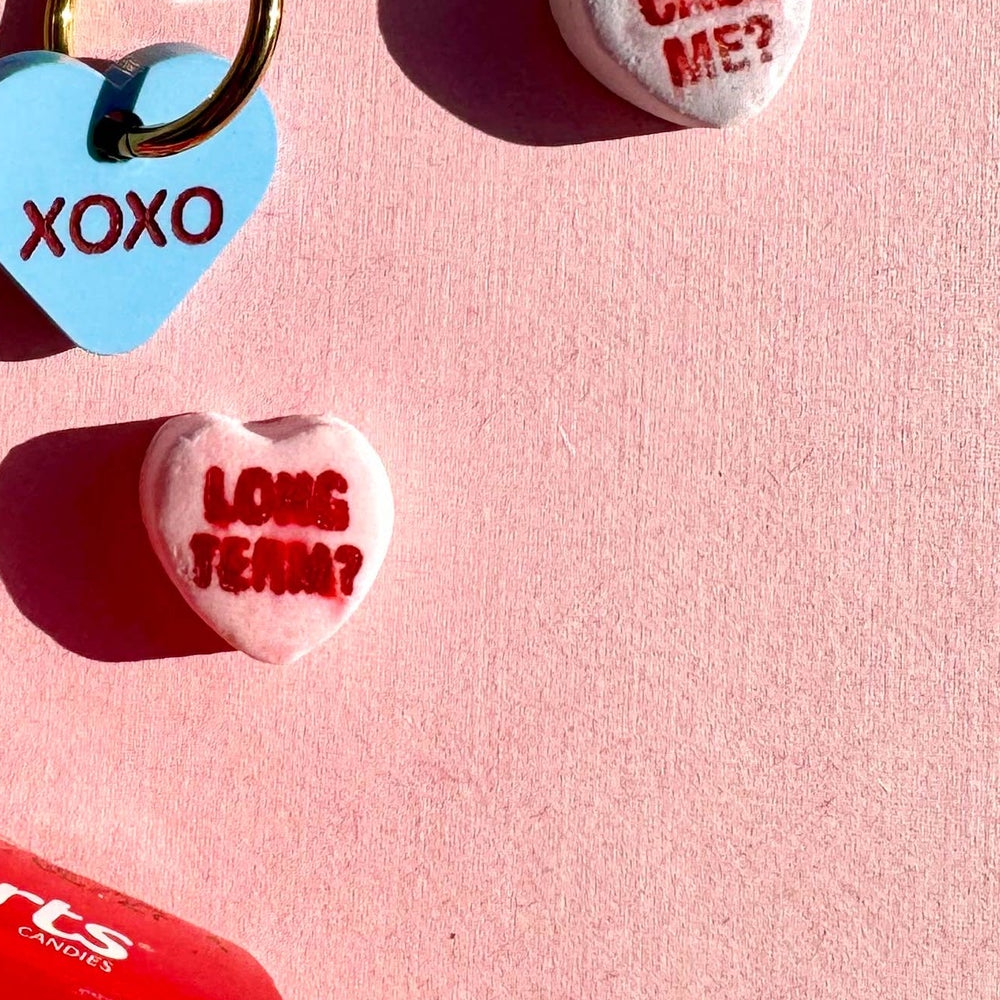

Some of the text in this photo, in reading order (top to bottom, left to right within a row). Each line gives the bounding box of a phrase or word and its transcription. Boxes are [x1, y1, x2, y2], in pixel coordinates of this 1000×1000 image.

[663, 14, 773, 88] ME?
[20, 186, 224, 261] XOXO
[203, 466, 350, 532] LONG
[18, 926, 114, 973] CANDIES
